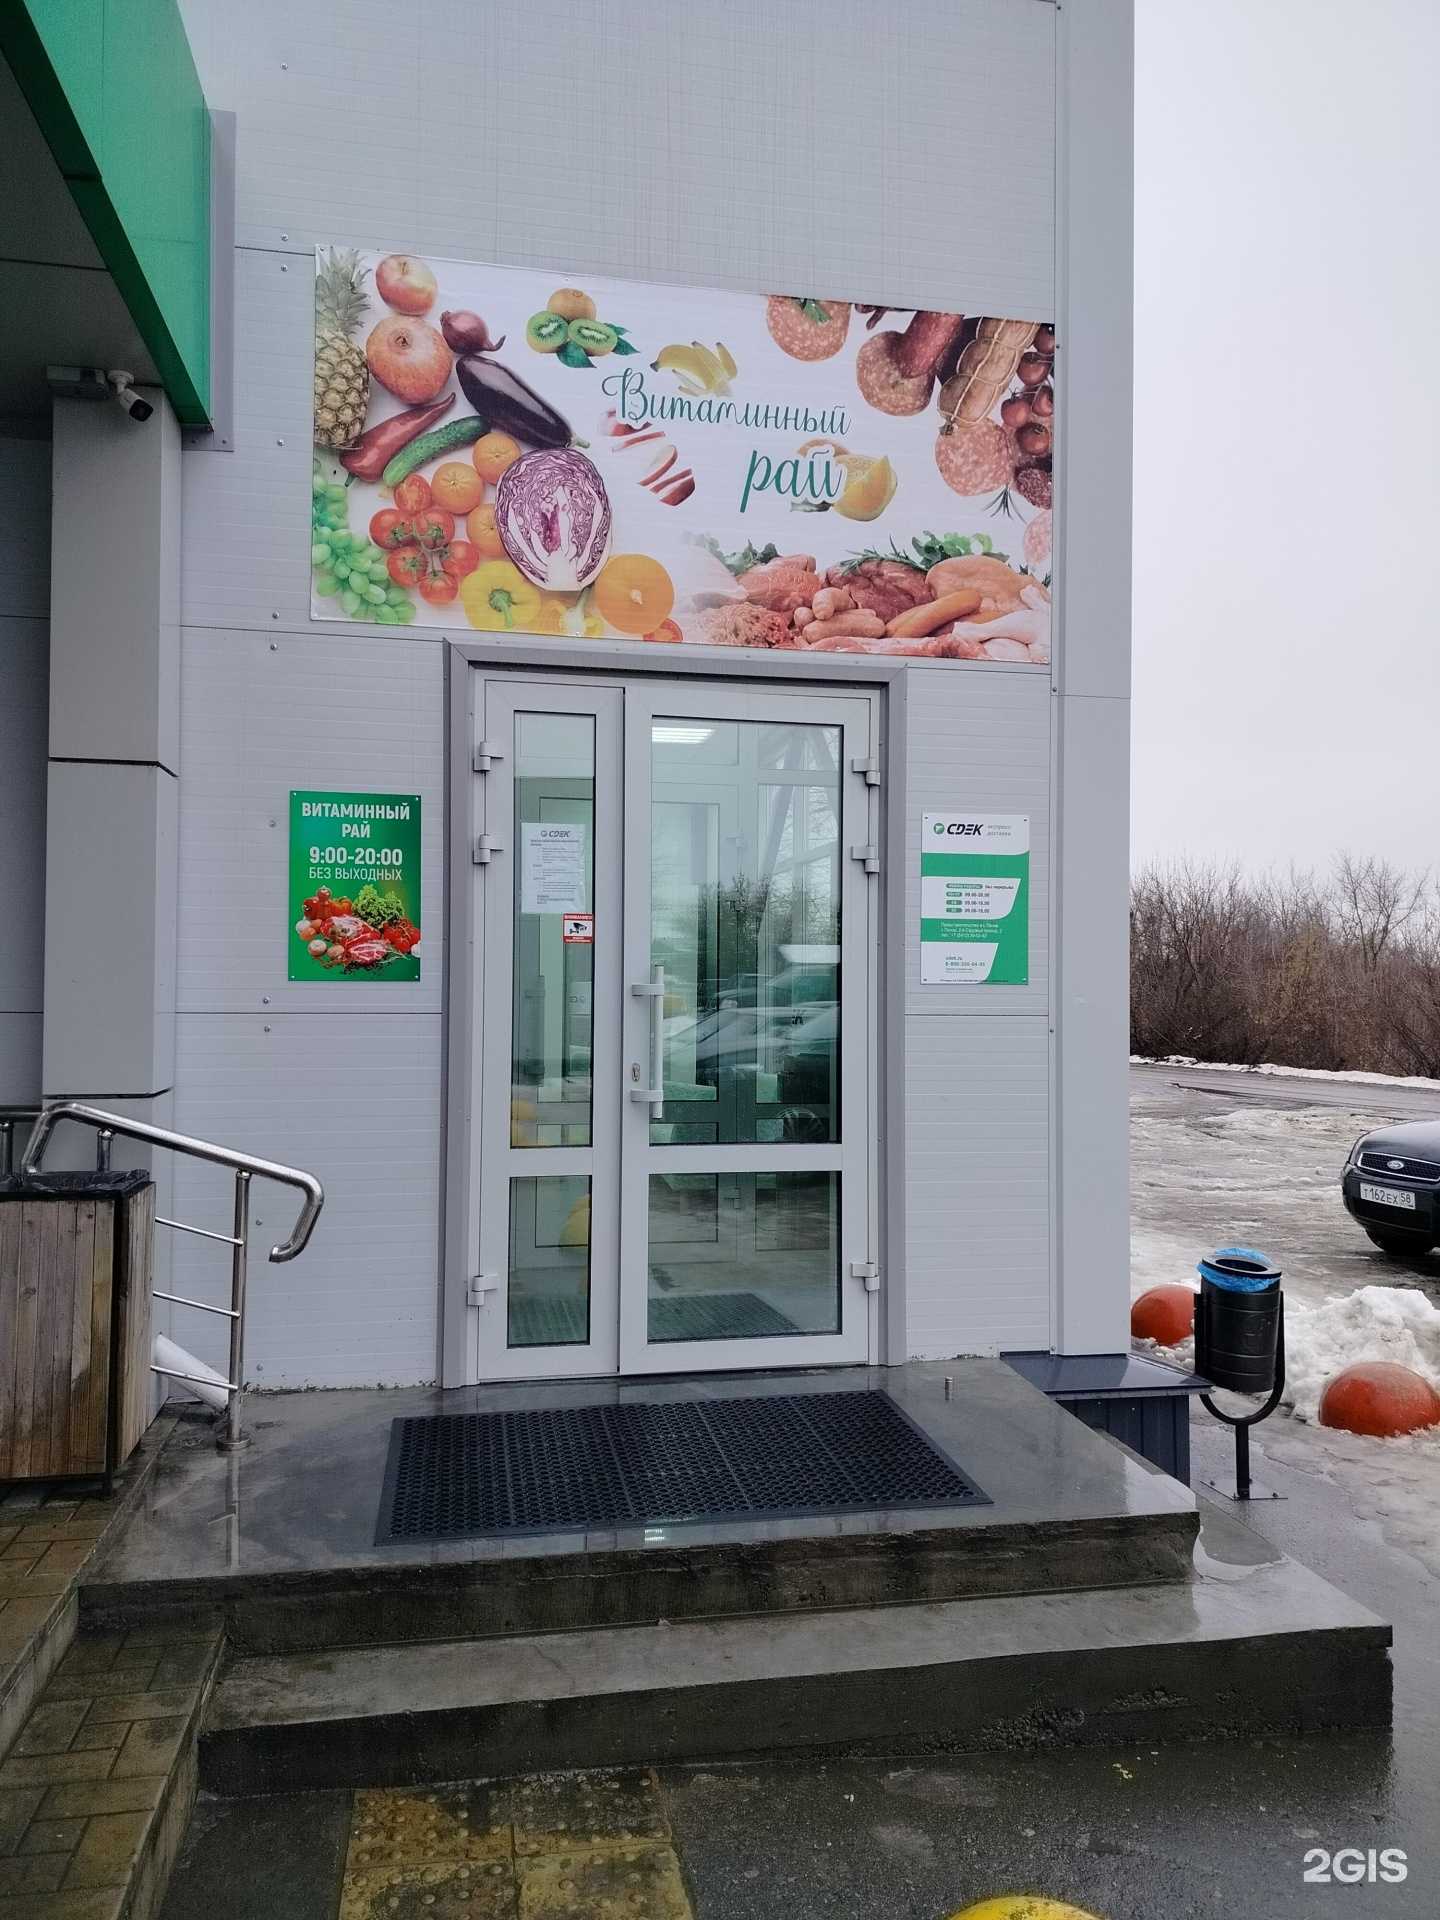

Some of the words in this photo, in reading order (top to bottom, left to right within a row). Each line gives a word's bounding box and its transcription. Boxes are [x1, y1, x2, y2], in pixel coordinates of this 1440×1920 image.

[601, 367, 852, 436] Витаминный
[740, 449, 843, 513] рай
[301, 802, 411, 821] ВИТАМИННЫЙ
[341, 821, 371, 839] РАЙ
[947, 823, 984, 836] CDEK
[309, 846, 403, 866] 9:00-20:00
[308, 866, 332, 880] БЕЗ
[335, 867, 403, 881] ВЫХОДНЫХ
